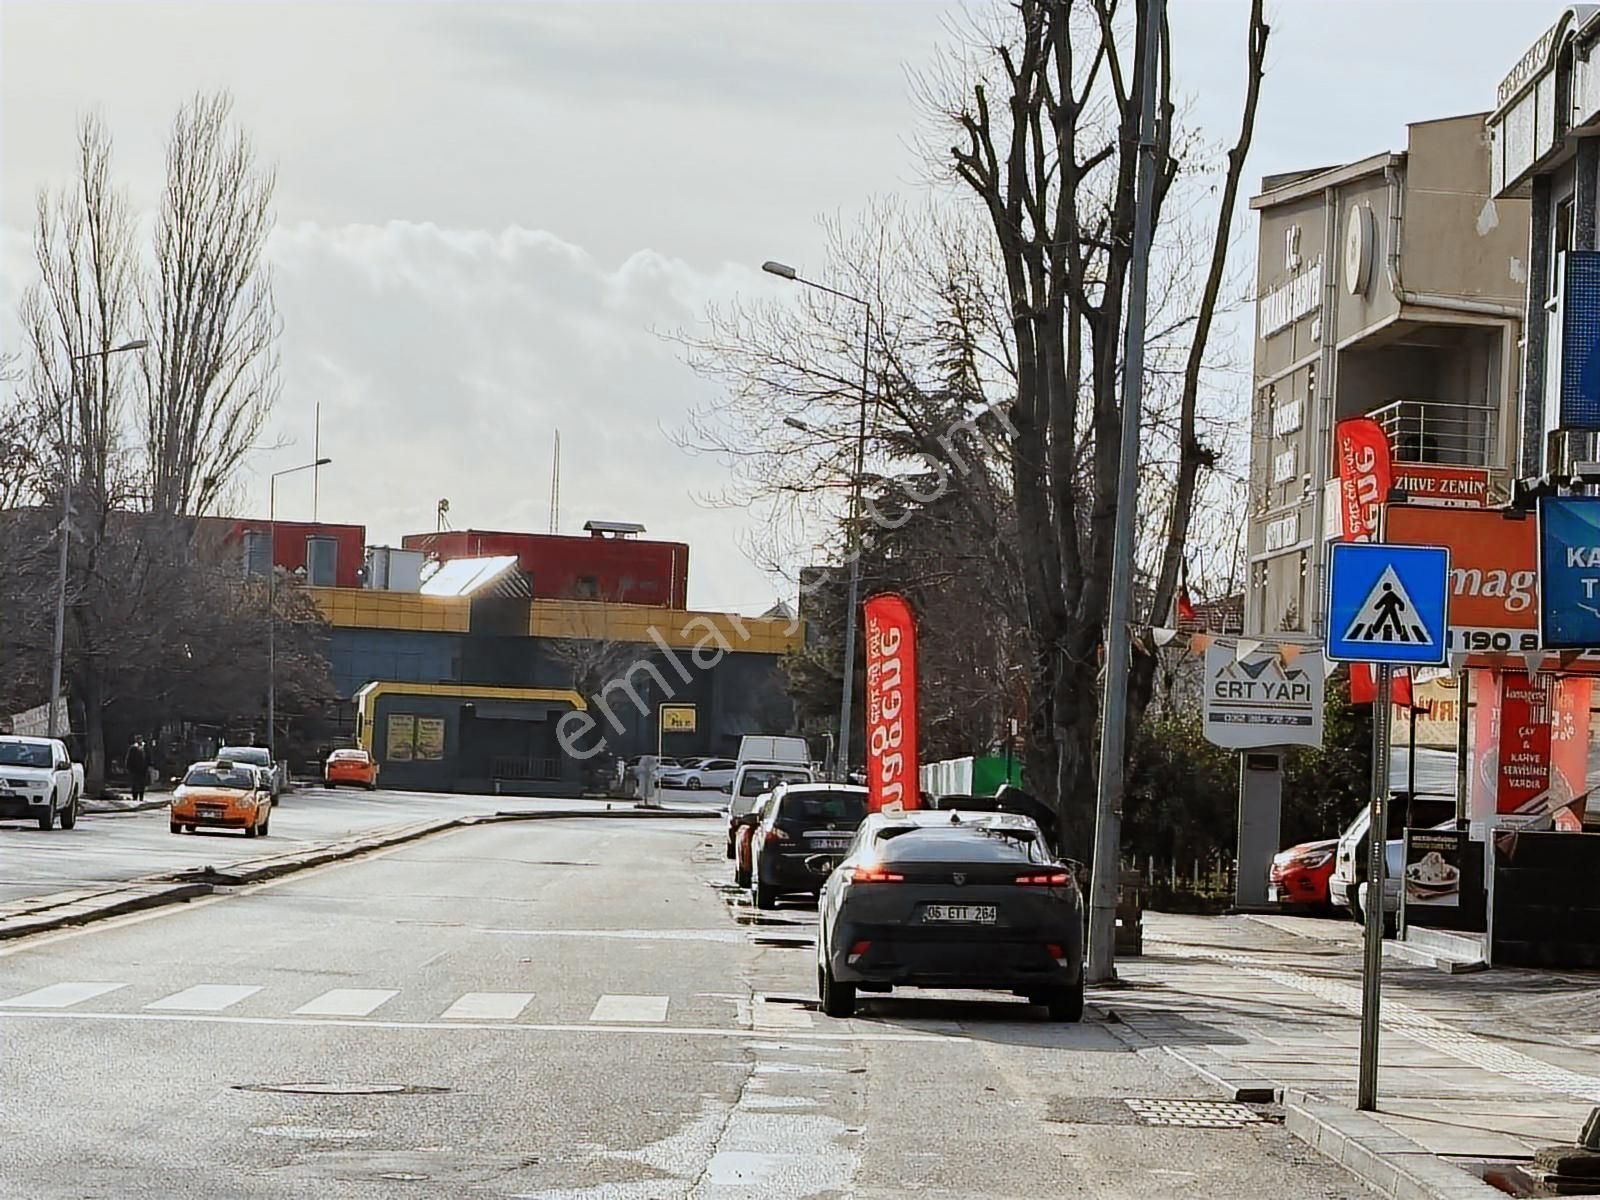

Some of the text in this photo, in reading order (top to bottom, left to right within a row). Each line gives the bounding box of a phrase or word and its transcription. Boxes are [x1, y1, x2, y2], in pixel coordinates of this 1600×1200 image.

[1440, 476, 1485, 495] ZEMİN
[1462, 631, 1512, 650] 190
[1262, 682, 1311, 702] YAPI
[1510, 753, 1541, 763] KAHVE
